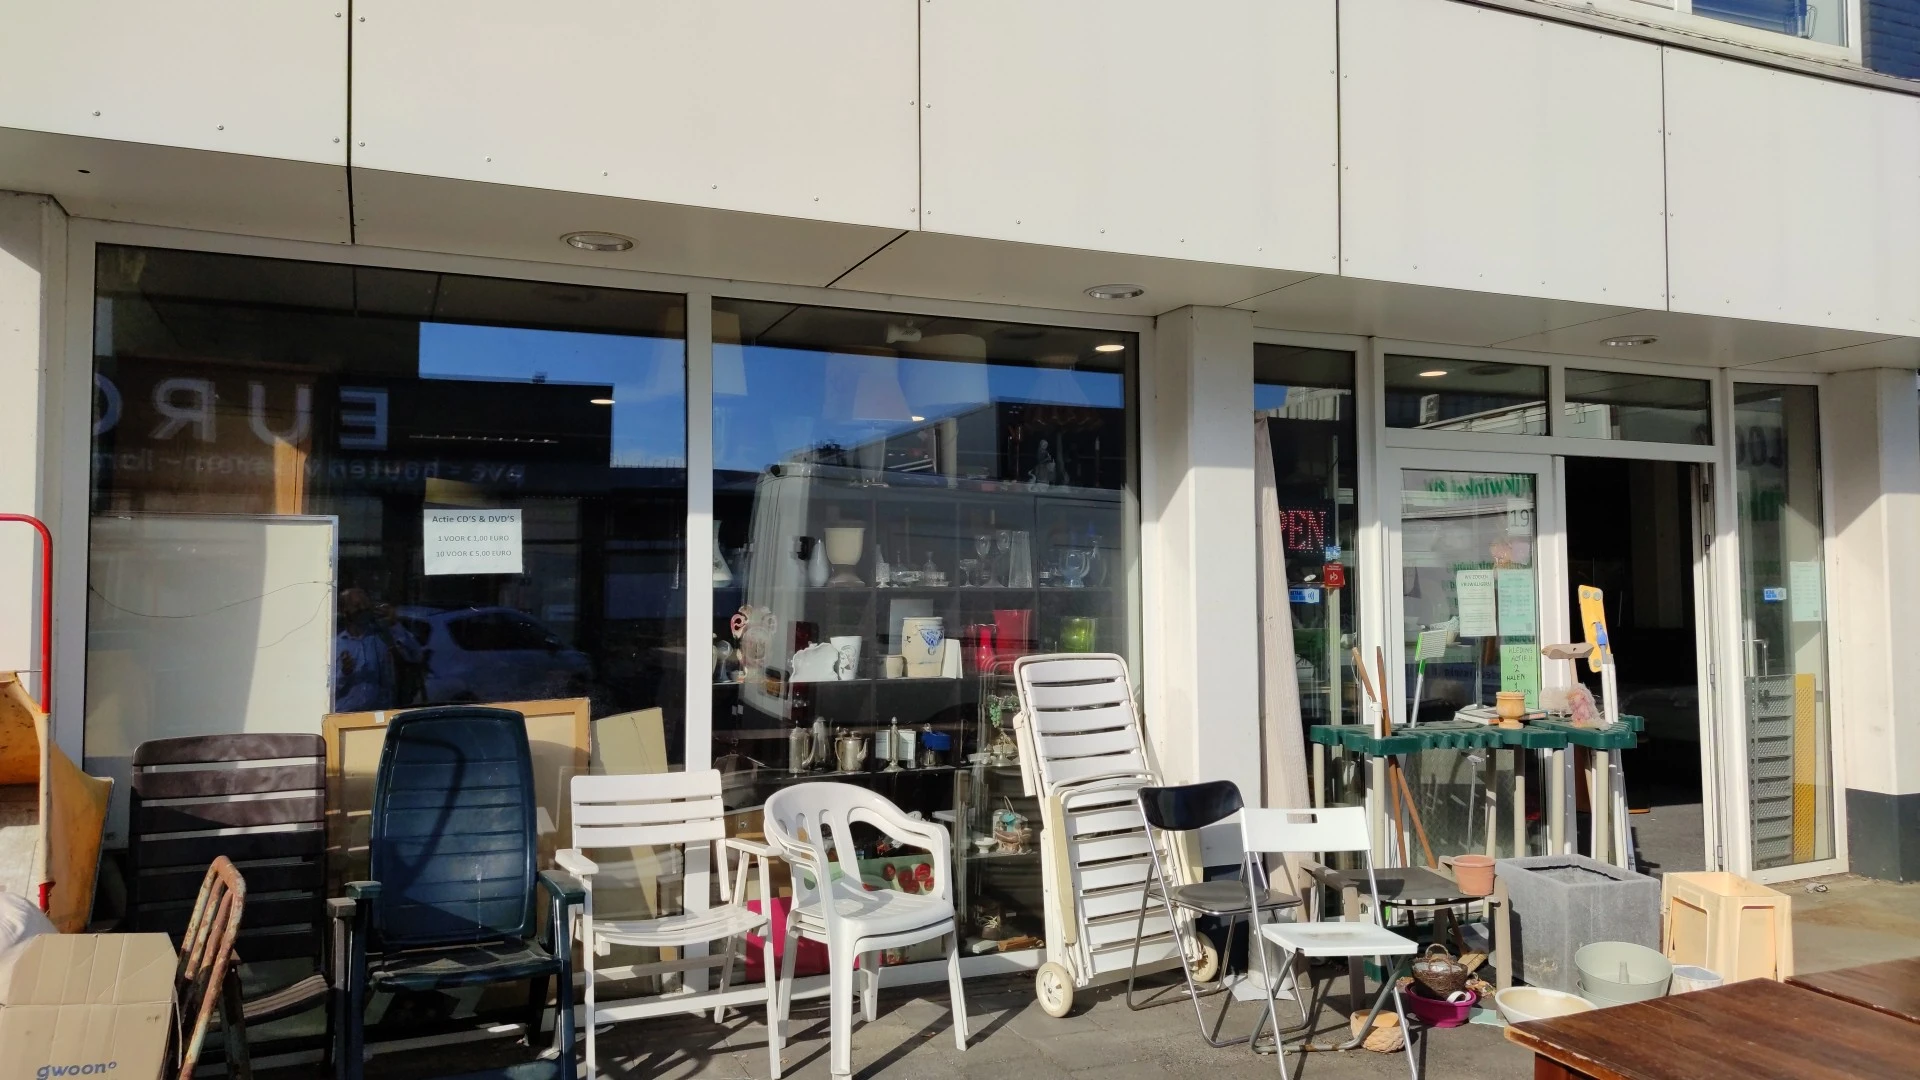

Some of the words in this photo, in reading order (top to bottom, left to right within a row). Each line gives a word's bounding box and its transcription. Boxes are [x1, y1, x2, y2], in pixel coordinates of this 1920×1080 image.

[432, 515, 455, 523] Actie
[456, 515, 477, 523] CD'S
[478, 515, 486, 523] &
[488, 515, 515, 523] DVD'S
[1510, 508, 1530, 528] 19
[1279, 510, 1327, 550] EN
[473, 535, 488, 543] 1,00
[476, 550, 491, 558] 5,00
